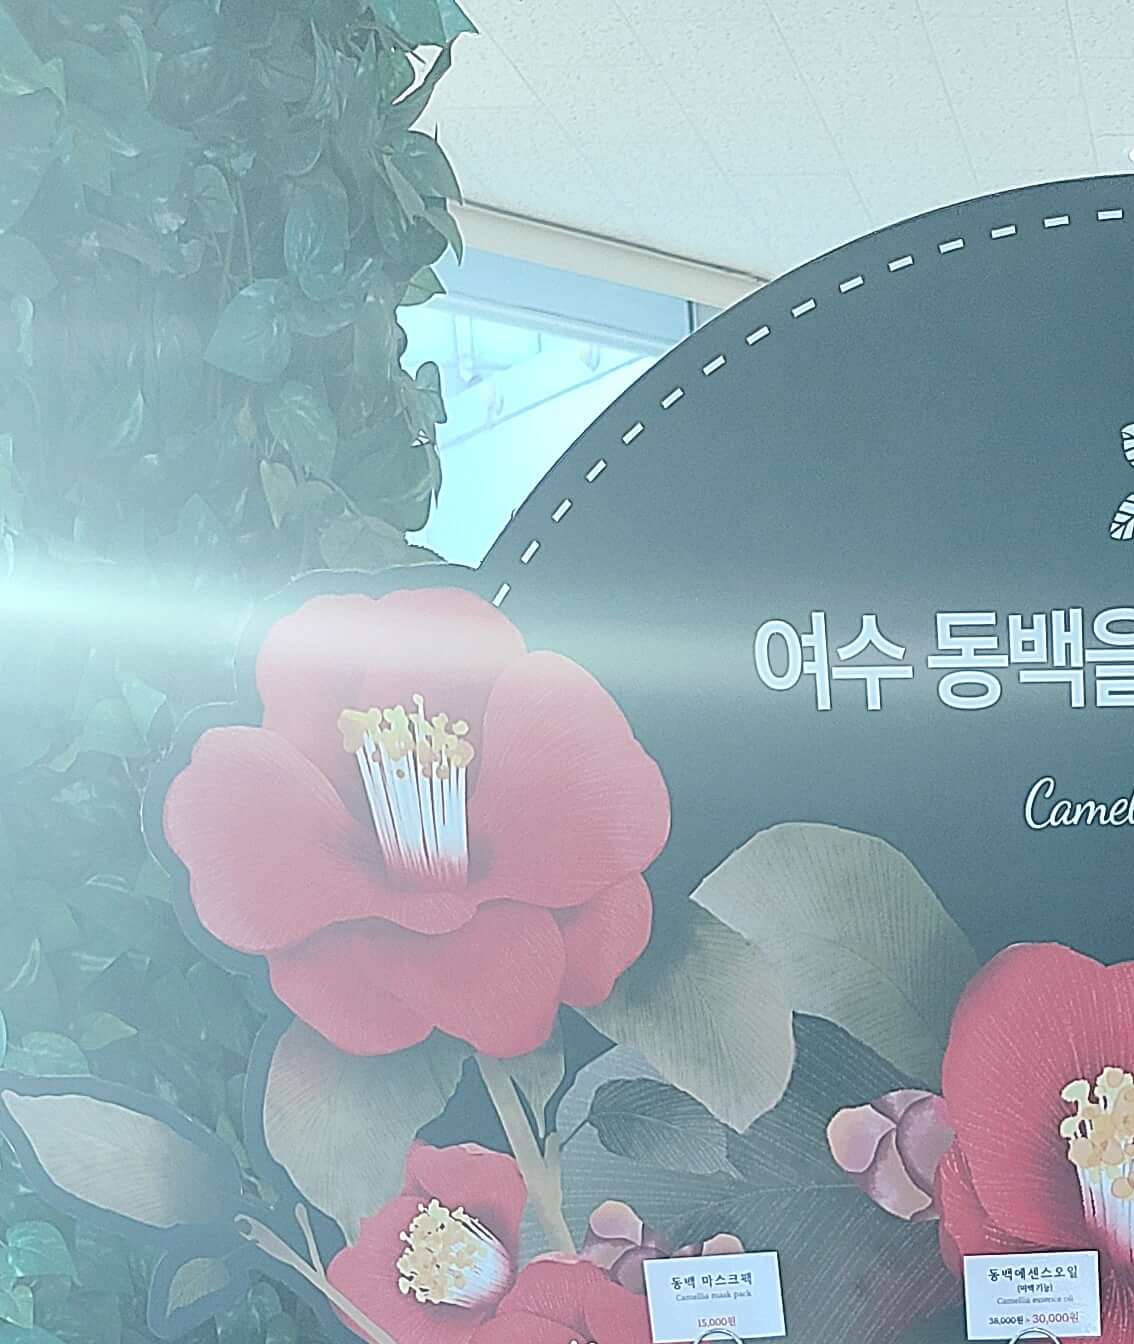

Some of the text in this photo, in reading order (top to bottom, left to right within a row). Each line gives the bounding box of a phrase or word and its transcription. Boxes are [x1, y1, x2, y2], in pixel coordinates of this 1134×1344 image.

[754, 610, 914, 711] 여수
[672, 1272, 752, 1290] 동백 마스크팩
[988, 1265, 1078, 1282] 동백에센스오일
[698, 1316, 736, 1328] 15,000원
[1032, 1312, 1079, 1324] 30,000원
